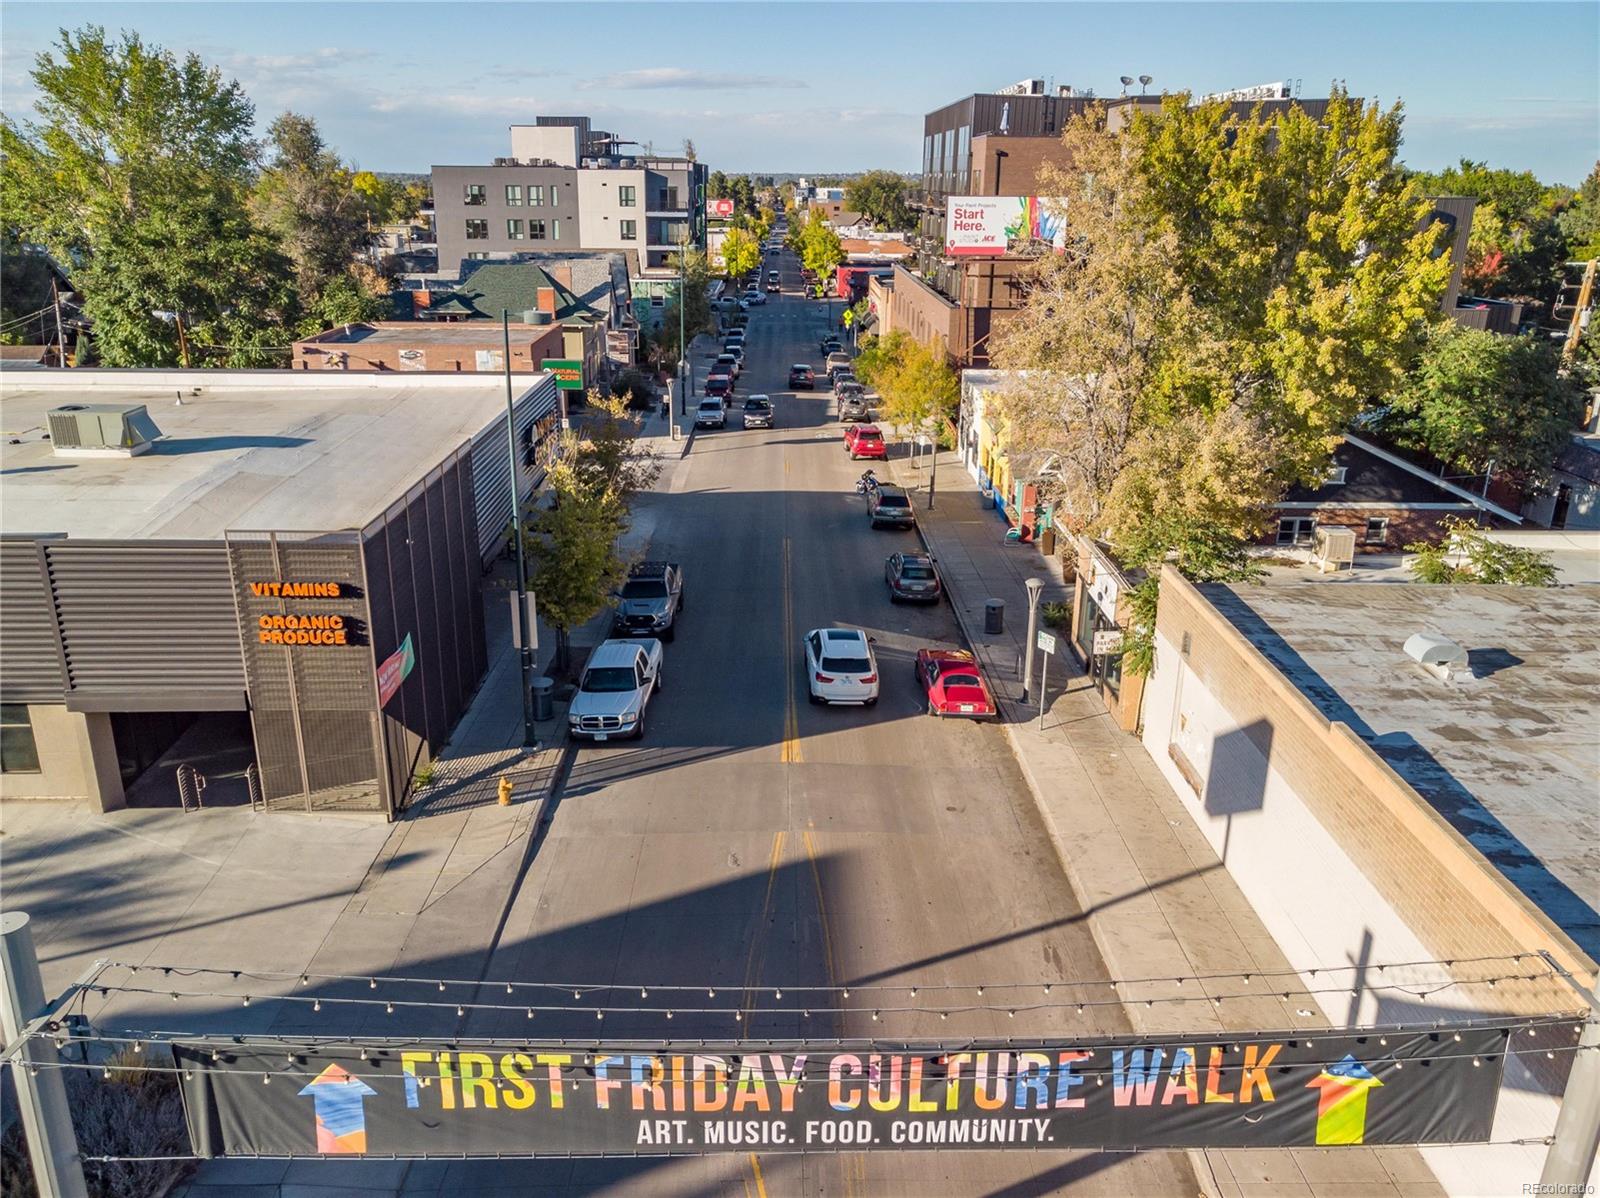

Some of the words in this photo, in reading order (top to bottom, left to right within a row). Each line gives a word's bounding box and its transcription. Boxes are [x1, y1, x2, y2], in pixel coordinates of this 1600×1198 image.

[954, 208, 984, 219] Start
[954, 220, 985, 231] Here.
[250, 582, 340, 597] VITAMINS
[259, 615, 343, 629] ORGANIC
[259, 630, 346, 645] PRODUCE
[400, 1051, 572, 1110] FIRST
[594, 1053, 808, 1112] FRIDAY
[828, 1052, 1091, 1113] CULTURE
[1111, 1045, 1282, 1107] WALK
[636, 1119, 693, 1145] ART.
[703, 1120, 795, 1145] MUSIC.
[805, 1120, 879, 1145] FOOD.
[890, 1117, 1055, 1144] COMMUNITY.
